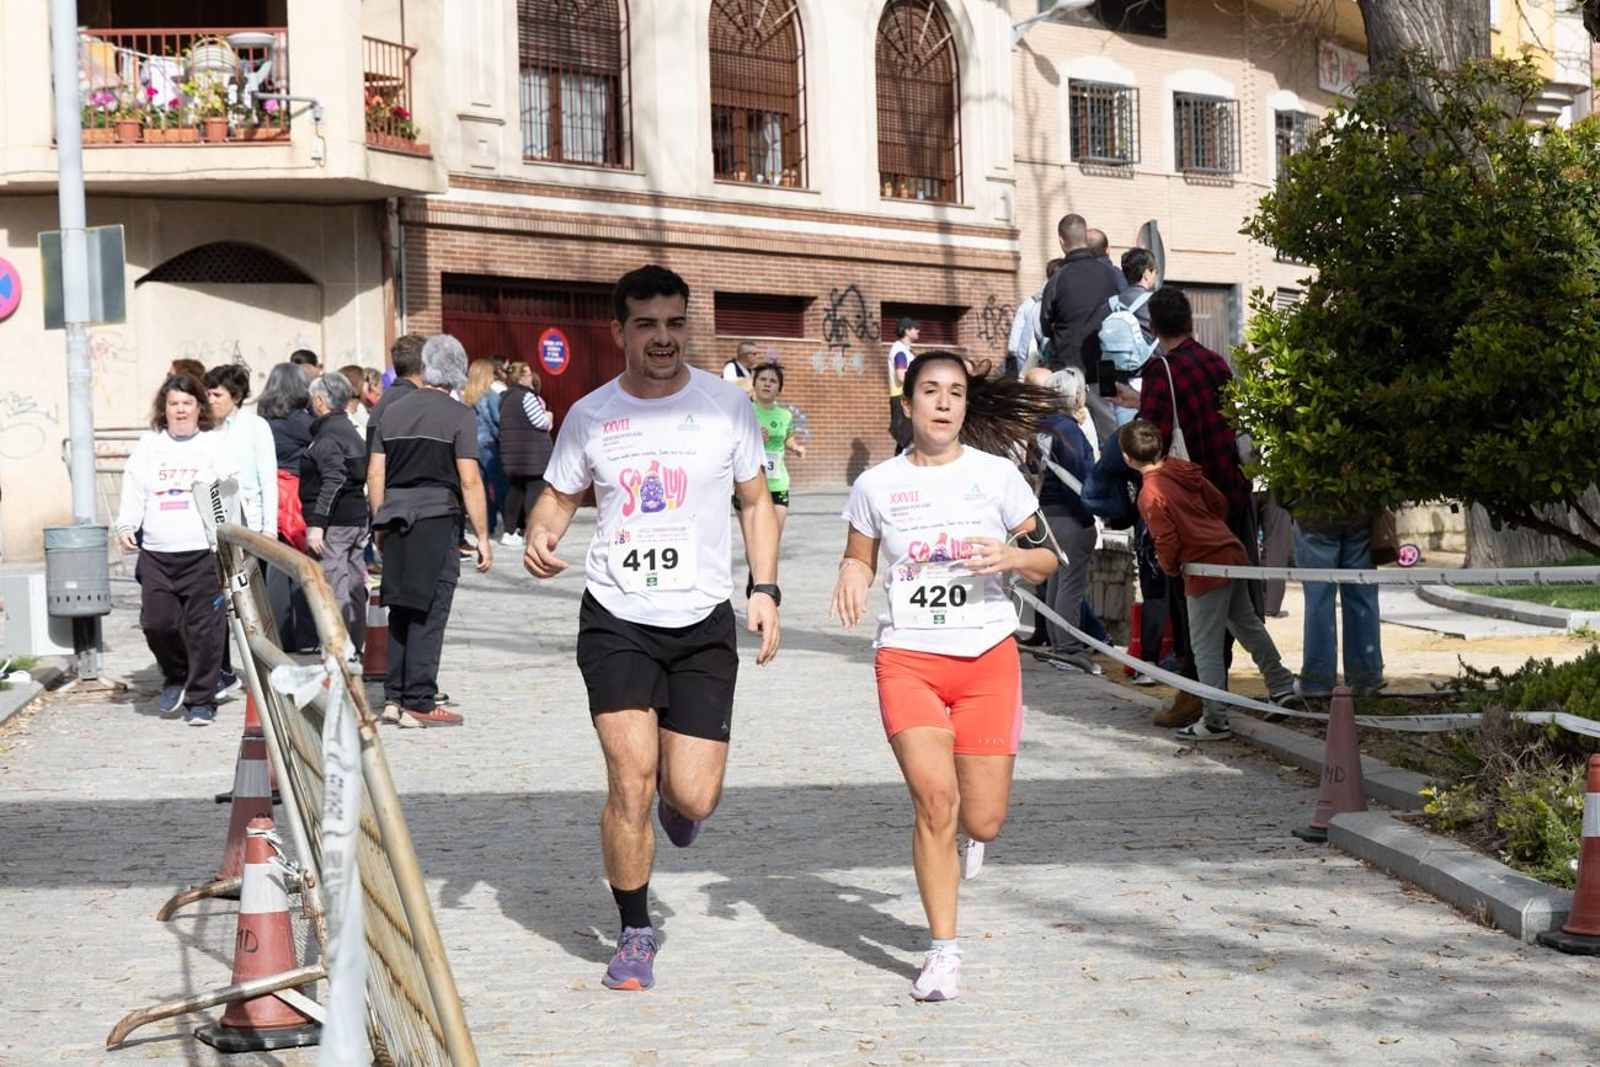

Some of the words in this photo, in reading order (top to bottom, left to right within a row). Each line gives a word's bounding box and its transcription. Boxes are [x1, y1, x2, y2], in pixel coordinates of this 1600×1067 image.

[602, 418, 630, 434] XXVII
[158, 468, 199, 481] 5777
[890, 490, 920, 504] XXVII
[622, 547, 679, 571] 419
[909, 584, 967, 608] 420
